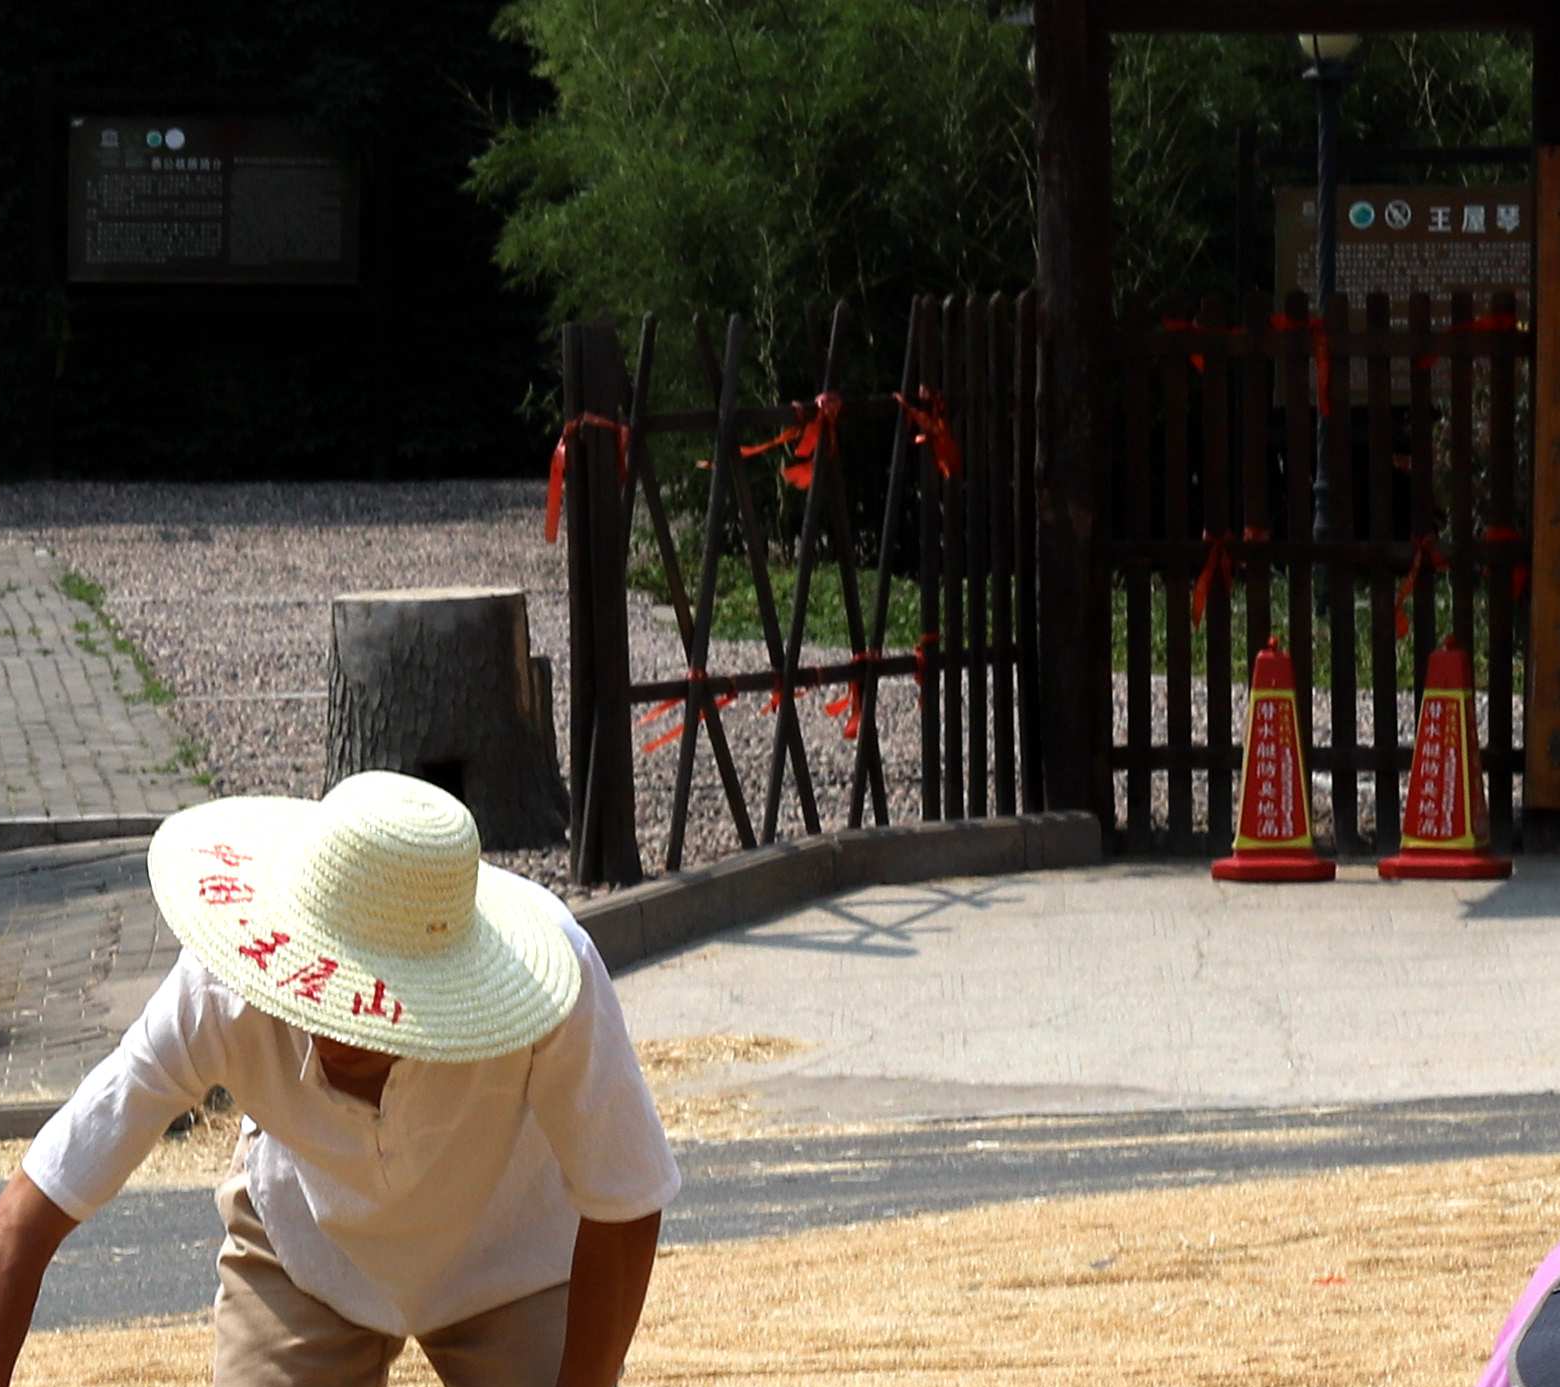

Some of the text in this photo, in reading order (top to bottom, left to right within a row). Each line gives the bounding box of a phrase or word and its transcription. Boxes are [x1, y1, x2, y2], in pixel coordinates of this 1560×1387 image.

[1256, 701, 1278, 838] 潜水艇防臭地漏
[1417, 700, 1443, 837] 潜水艇防臭地漏
